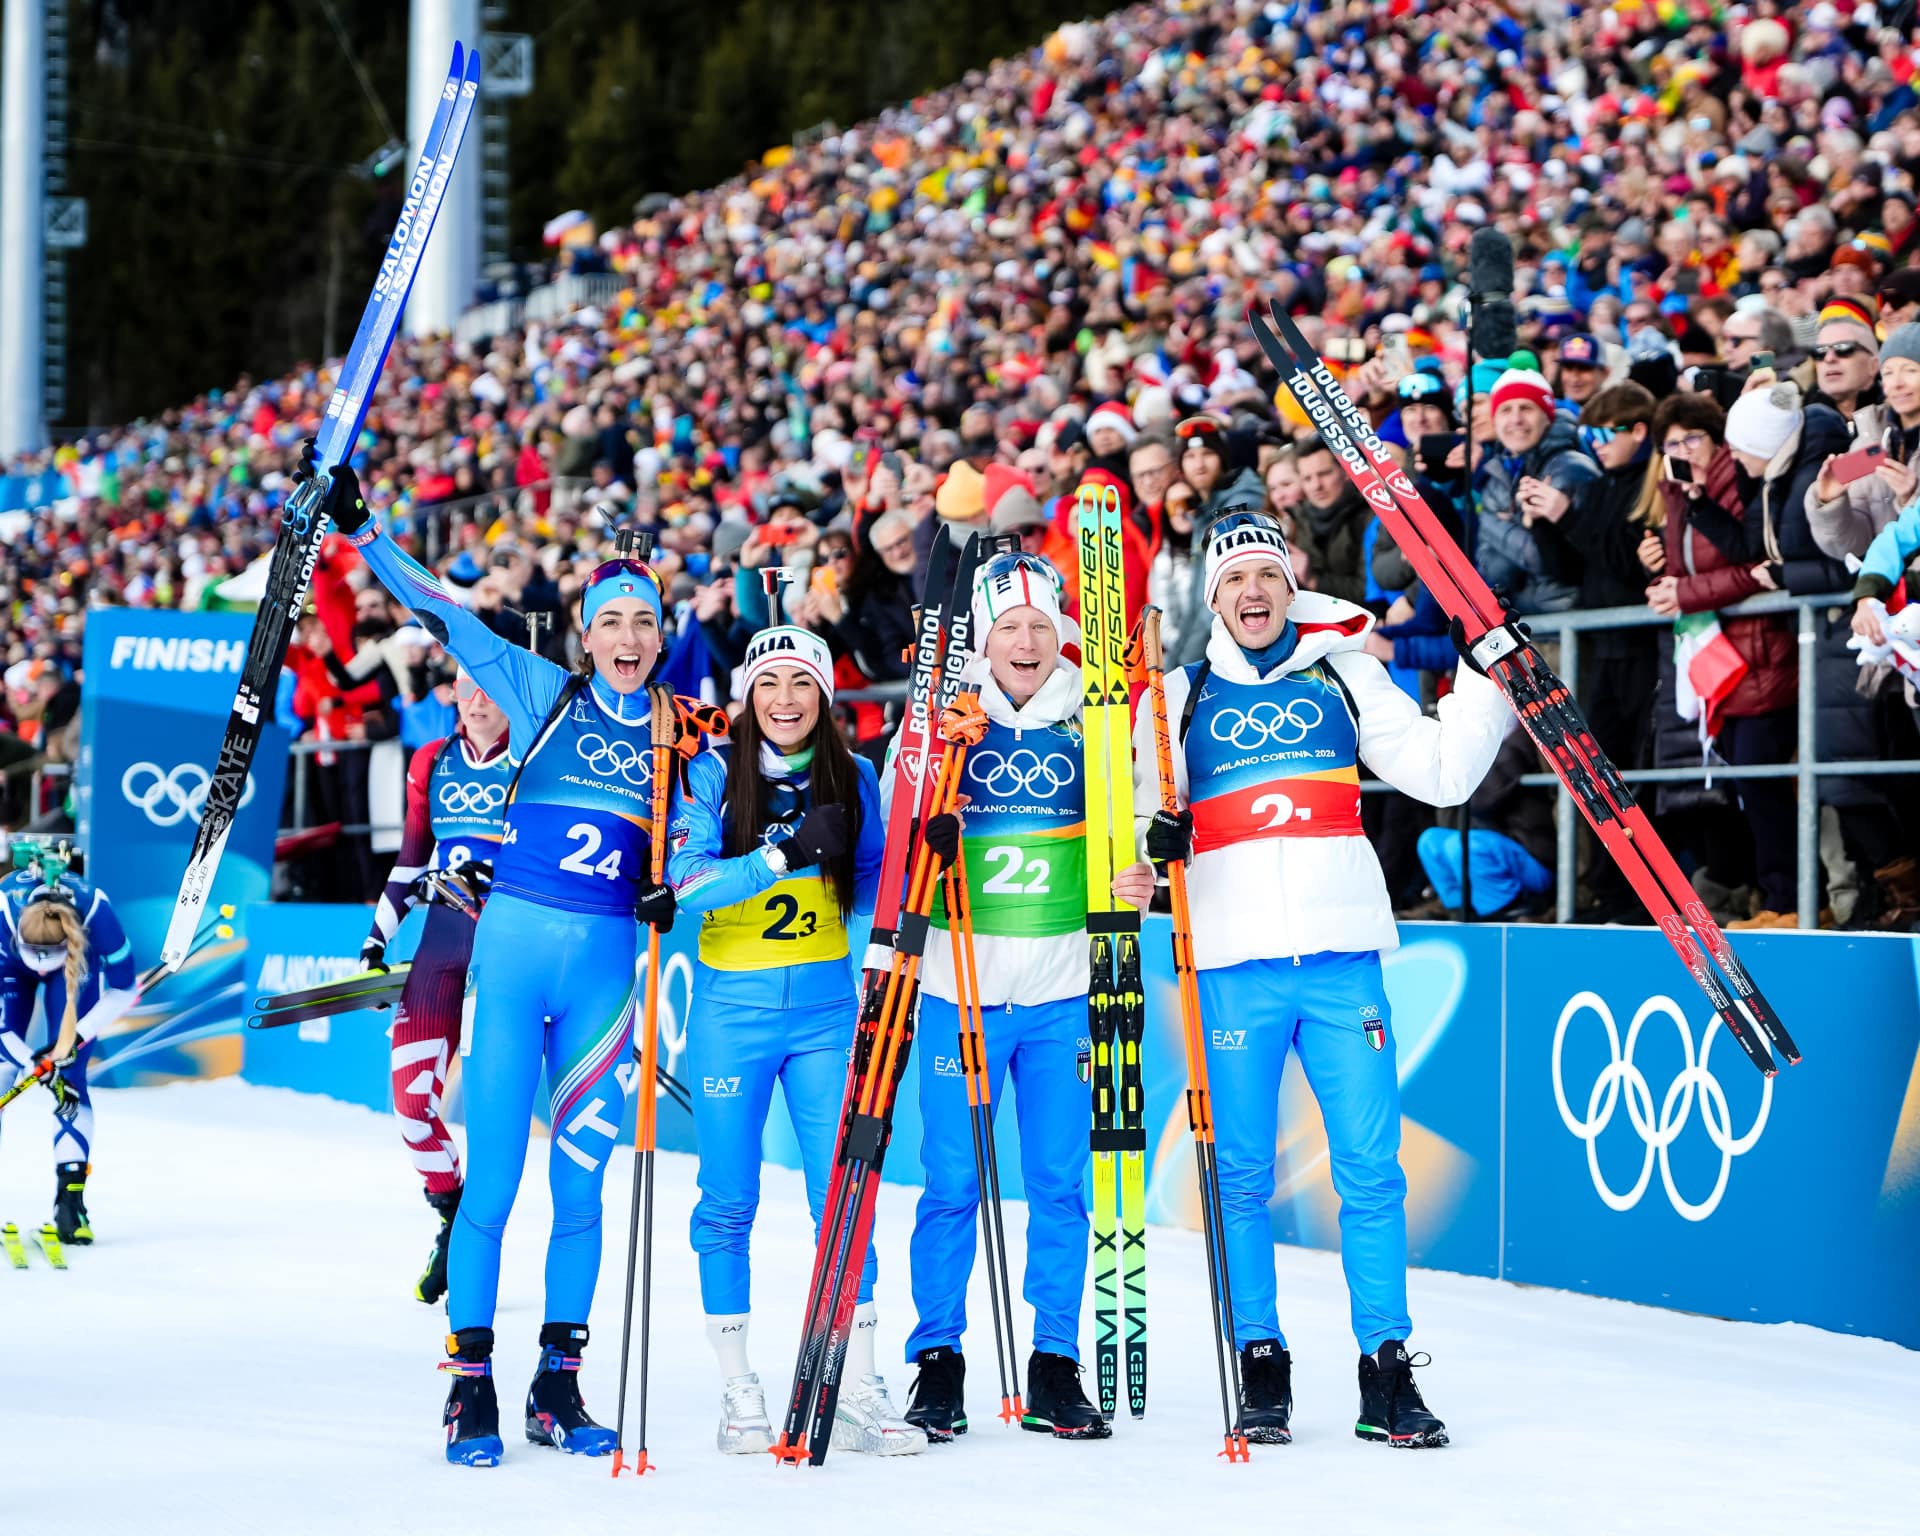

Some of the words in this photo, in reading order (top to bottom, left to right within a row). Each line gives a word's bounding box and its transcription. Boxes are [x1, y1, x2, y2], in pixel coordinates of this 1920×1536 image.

[375, 155, 434, 295] SALOMON
[394, 154, 454, 290] SALOMON
[1288, 367, 1370, 476] ROSSIGNOL
[1309, 357, 1392, 465] ROSSIGNOL
[288, 512, 331, 620] SALOMON
[1215, 530, 1287, 557] ITALIA
[1083, 527, 1100, 669] FISCHER
[1105, 526, 1124, 667] FISCHER
[110, 635, 246, 673] FINISH
[747, 636, 796, 668] ALIA
[909, 603, 942, 733] ROSSIGNOL
[937, 610, 970, 740] SSIGNOL
[212, 734, 252, 829] SKATE
[1212, 756, 1259, 776] MILANO
[1261, 750, 1313, 763] CORTINA
[1314, 749, 1336, 758] 2026
[560, 775, 603, 789] MILANO
[604, 783, 644, 802] CORTINA
[960, 805, 1007, 814] MILANO
[1009, 805, 1057, 815] CORTINA
[502, 821, 518, 845] 24
[560, 823, 622, 881] 24
[982, 846, 1050, 894] 22
[761, 893, 817, 941] 23
[1692, 965, 1725, 1010] PREMIUM
[1716, 951, 1750, 997] PREMIUM
[1212, 1030, 1247, 1046] EA7
[703, 1076, 742, 1093] EA7
[721, 1324, 744, 1333] EA7
[858, 1320, 878, 1329] EA7
[823, 1330, 839, 1384] PREMIUM
[1252, 1344, 1271, 1357] EA7
[1102, 1353, 1115, 1410] SPEED
[1131, 1351, 1144, 1409] SPEED
